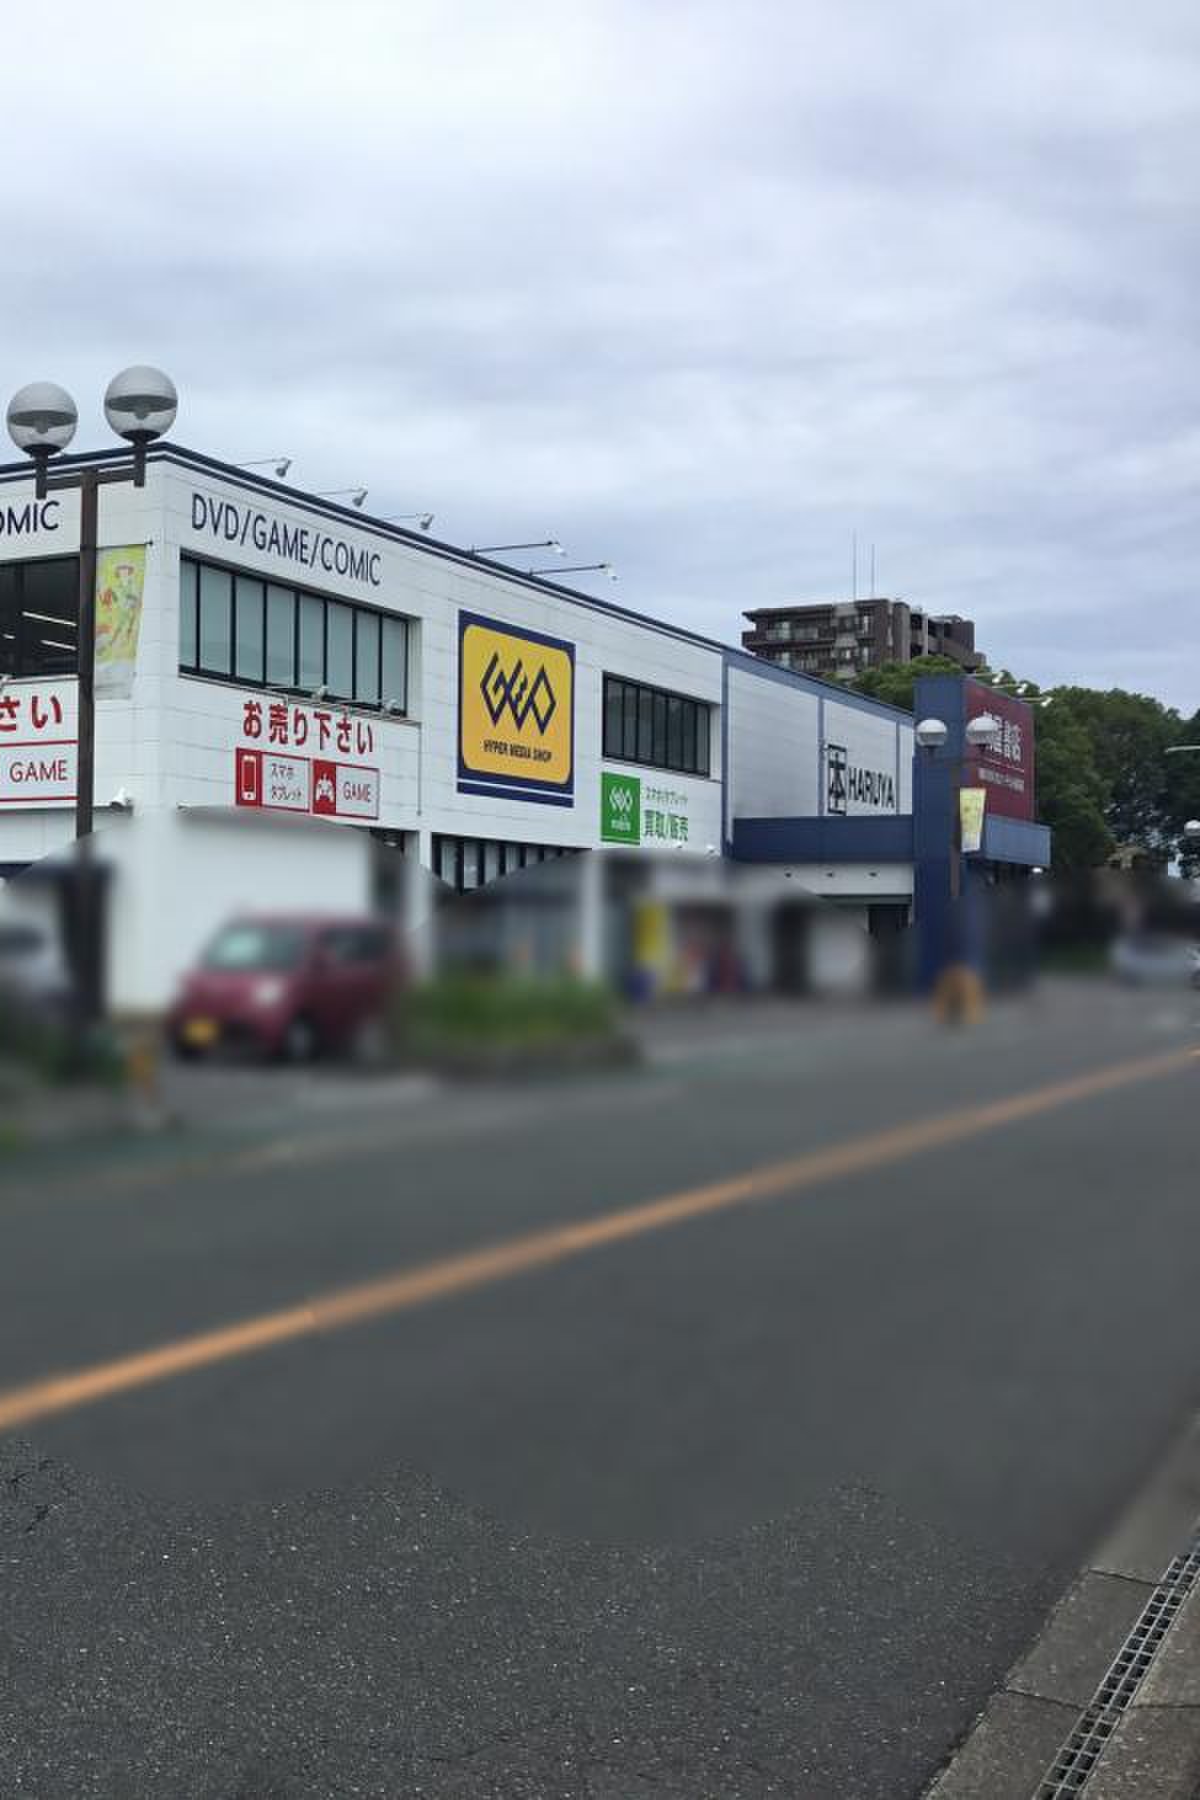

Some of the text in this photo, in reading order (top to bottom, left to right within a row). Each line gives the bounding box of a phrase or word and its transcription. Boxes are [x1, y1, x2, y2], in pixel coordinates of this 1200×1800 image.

[192, 493, 382, 586] DVD/GAME/COMIC
[480, 651, 557, 737] GEO
[243, 700, 374, 755] お売り下さい
[9, 760, 68, 783] GAME
[343, 781, 372, 803] GAME
